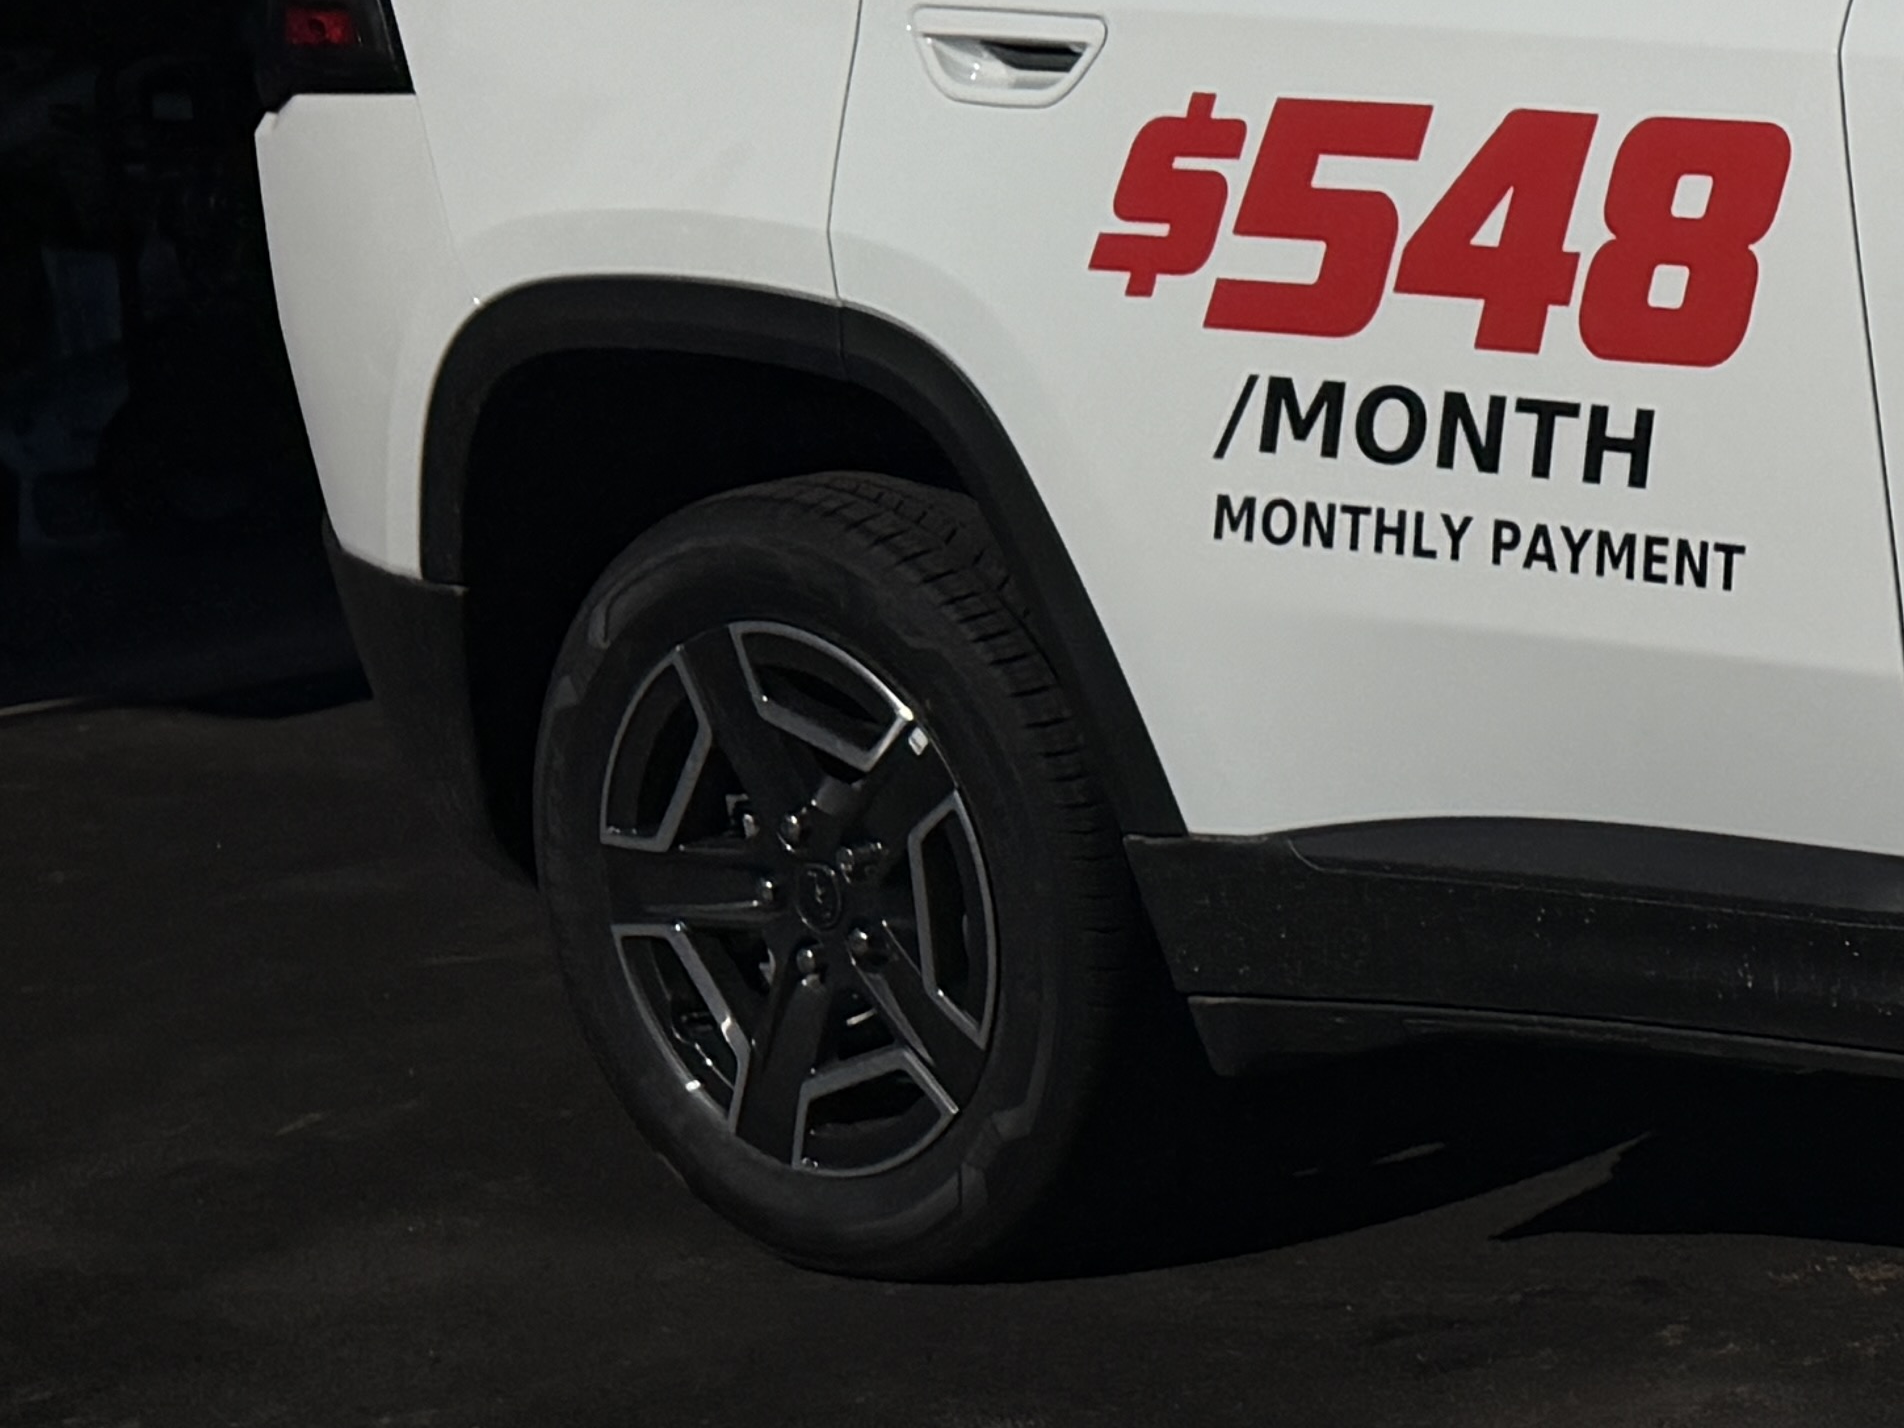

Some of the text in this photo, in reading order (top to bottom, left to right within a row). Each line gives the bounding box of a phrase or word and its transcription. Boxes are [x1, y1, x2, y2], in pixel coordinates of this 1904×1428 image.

[1089, 92, 1793, 369] $548
[1212, 373, 1656, 490] /MONTH
[1212, 493, 1747, 592] MONTHLY PAYMENT
